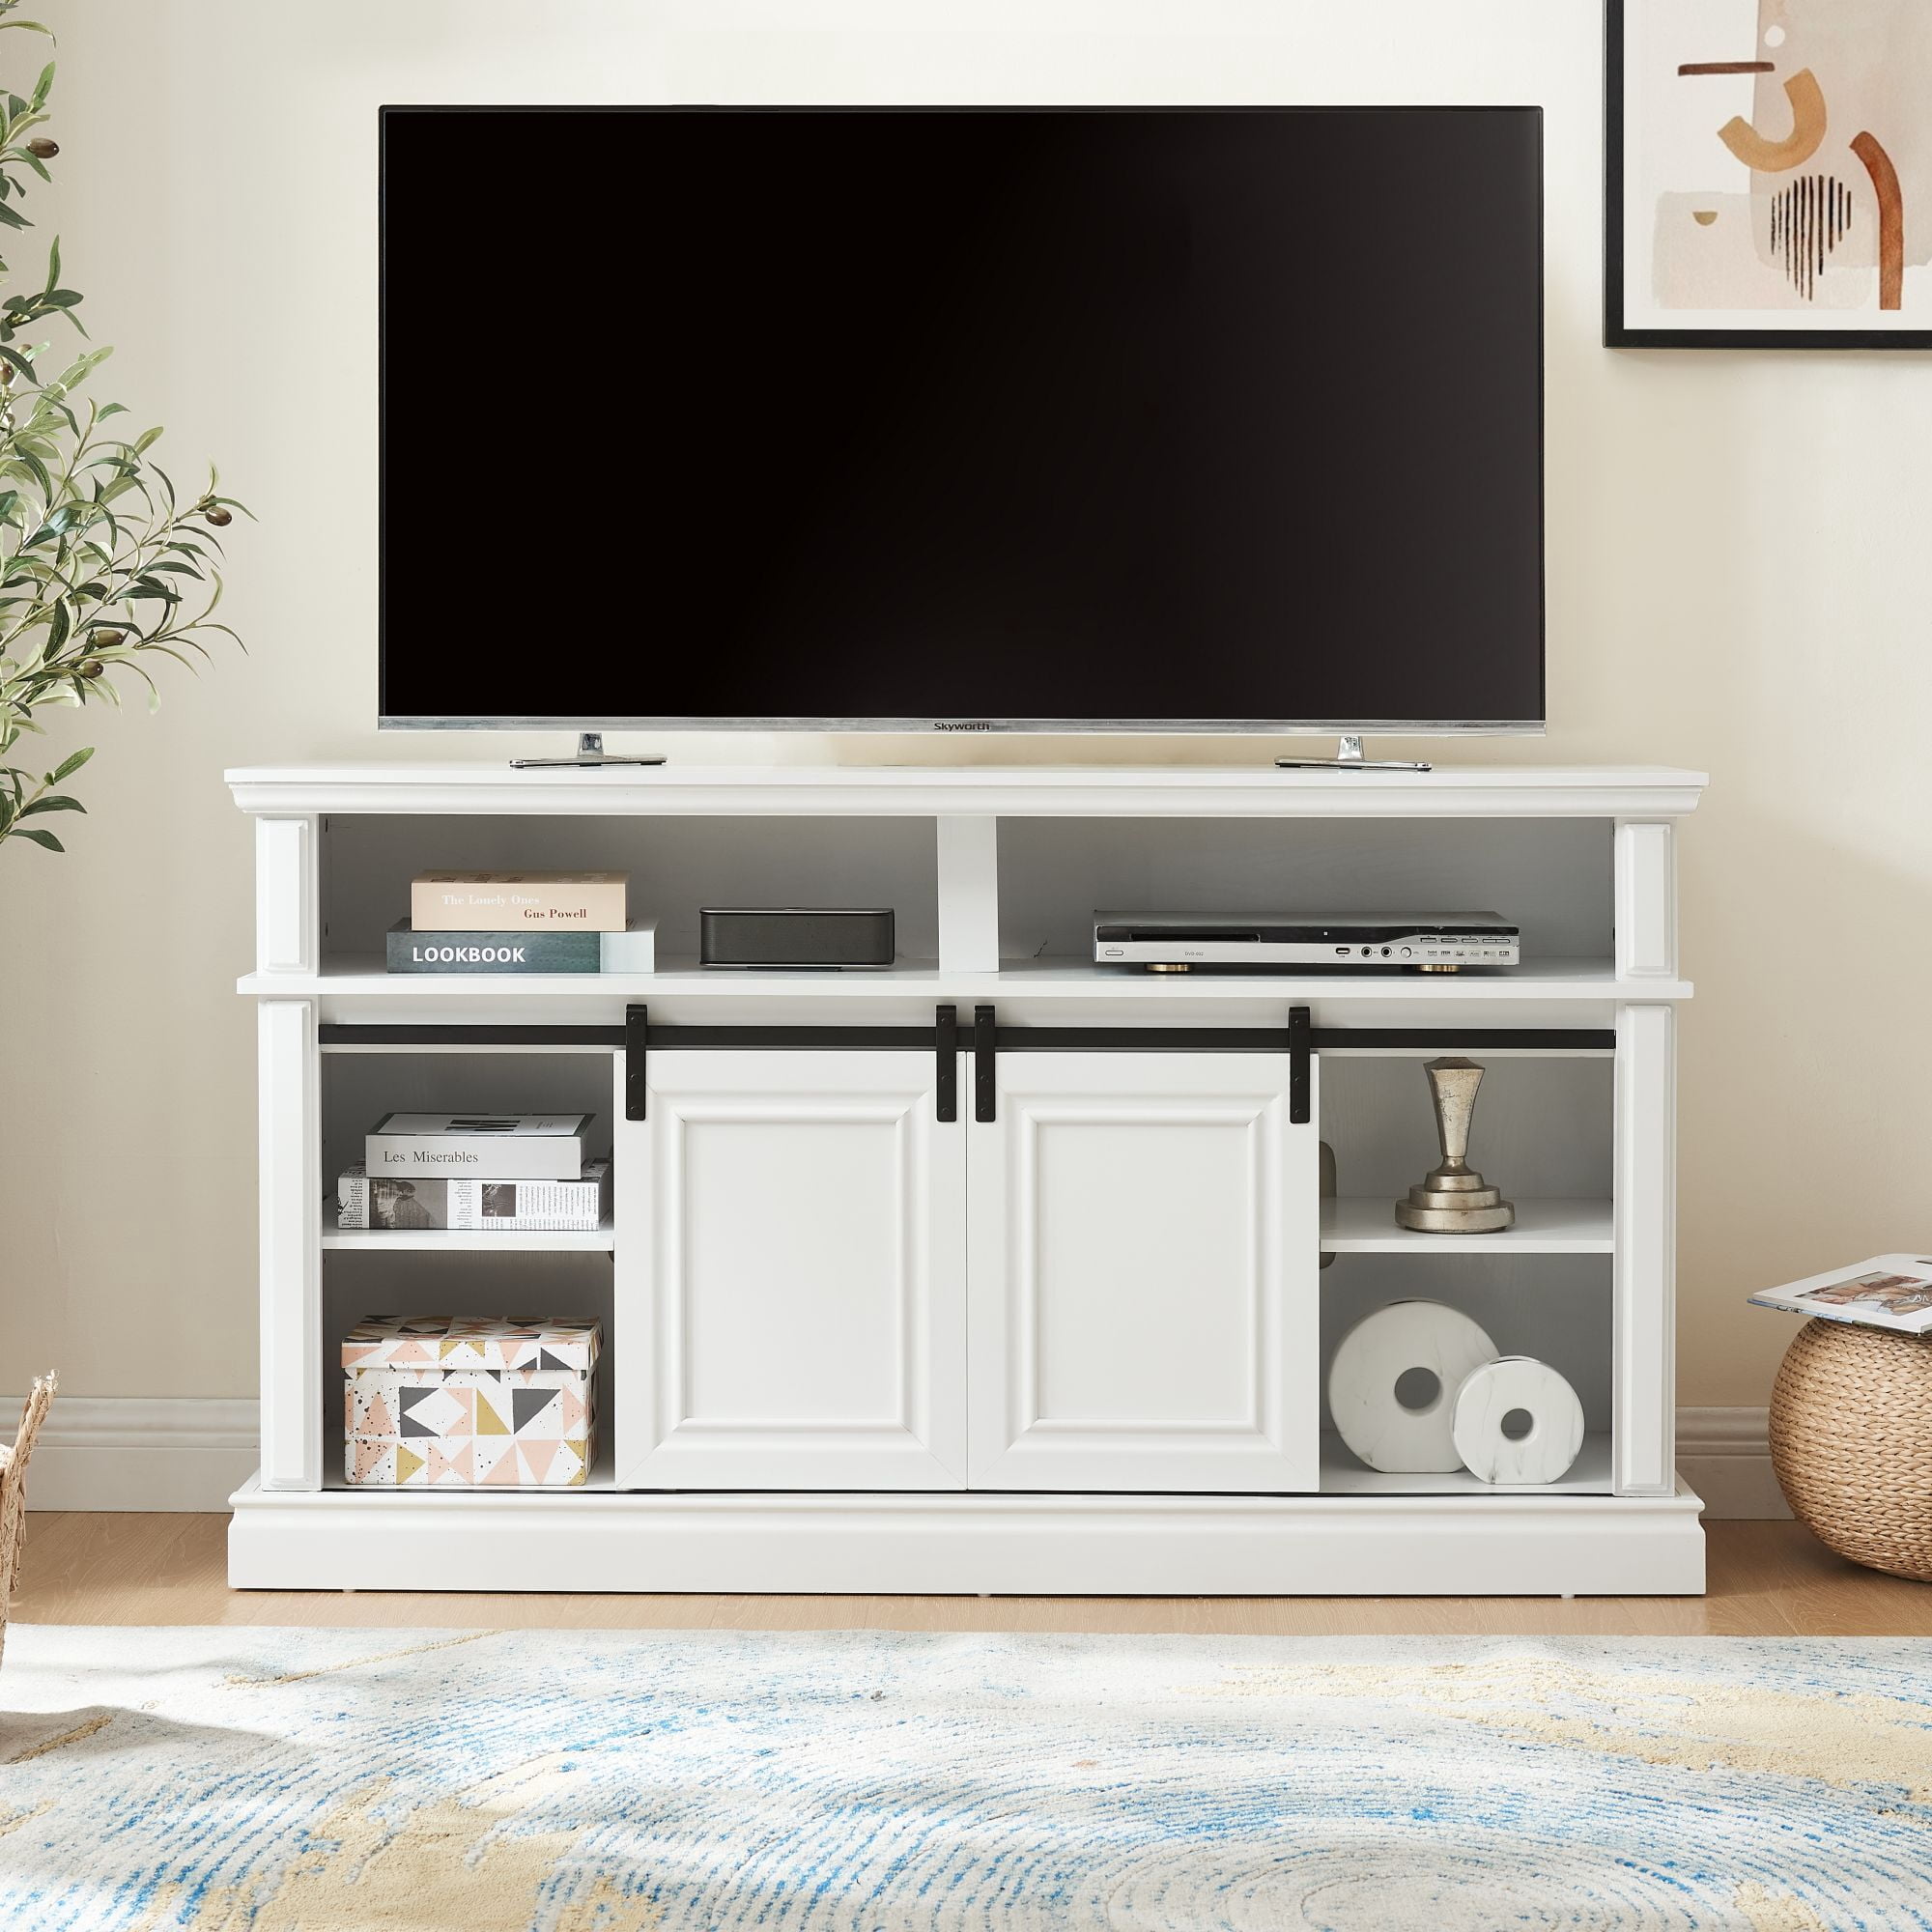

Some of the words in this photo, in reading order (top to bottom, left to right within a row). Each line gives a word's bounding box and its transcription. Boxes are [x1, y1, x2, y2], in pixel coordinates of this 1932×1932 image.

[934, 723, 989, 731] Skyworth
[442, 895, 465, 905] The
[469, 895, 507, 907] Lonely
[511, 895, 540, 905] Ones
[524, 908, 545, 919] Gus
[550, 908, 587, 919] Powell
[412, 947, 526, 963] LOOKBOOK
[384, 1151, 406, 1163] Les
[413, 1151, 479, 1163] Miserables
